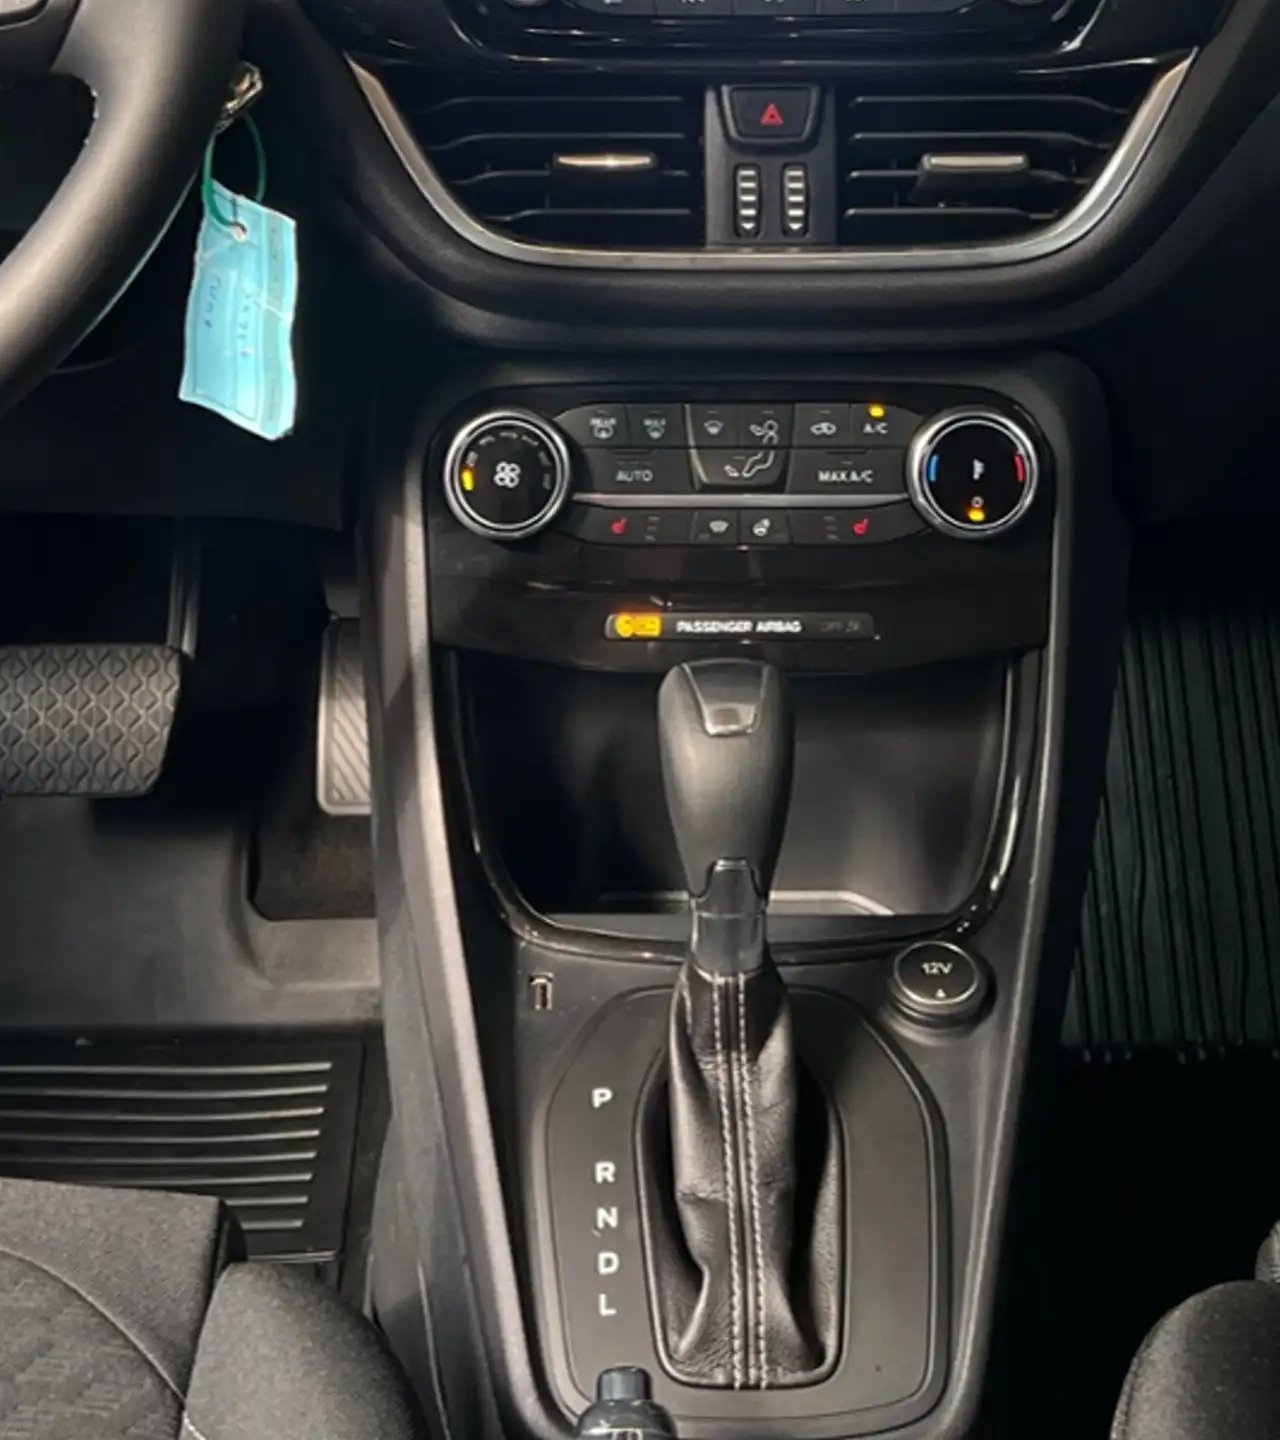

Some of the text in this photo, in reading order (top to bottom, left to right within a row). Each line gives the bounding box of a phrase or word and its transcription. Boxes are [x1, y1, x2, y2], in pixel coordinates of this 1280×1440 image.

[862, 421, 889, 434] A/C
[616, 470, 654, 483] AUTO
[817, 469, 874, 483] MAX A/C
[675, 619, 753, 634] PASSENGER
[755, 619, 803, 634] AIRBAG
[920, 962, 953, 975] 12V
[591, 1087, 613, 1109] P
[594, 1161, 617, 1184] R
[596, 1206, 619, 1229] N
[597, 1251, 620, 1275] D
[598, 1293, 618, 1317] L
